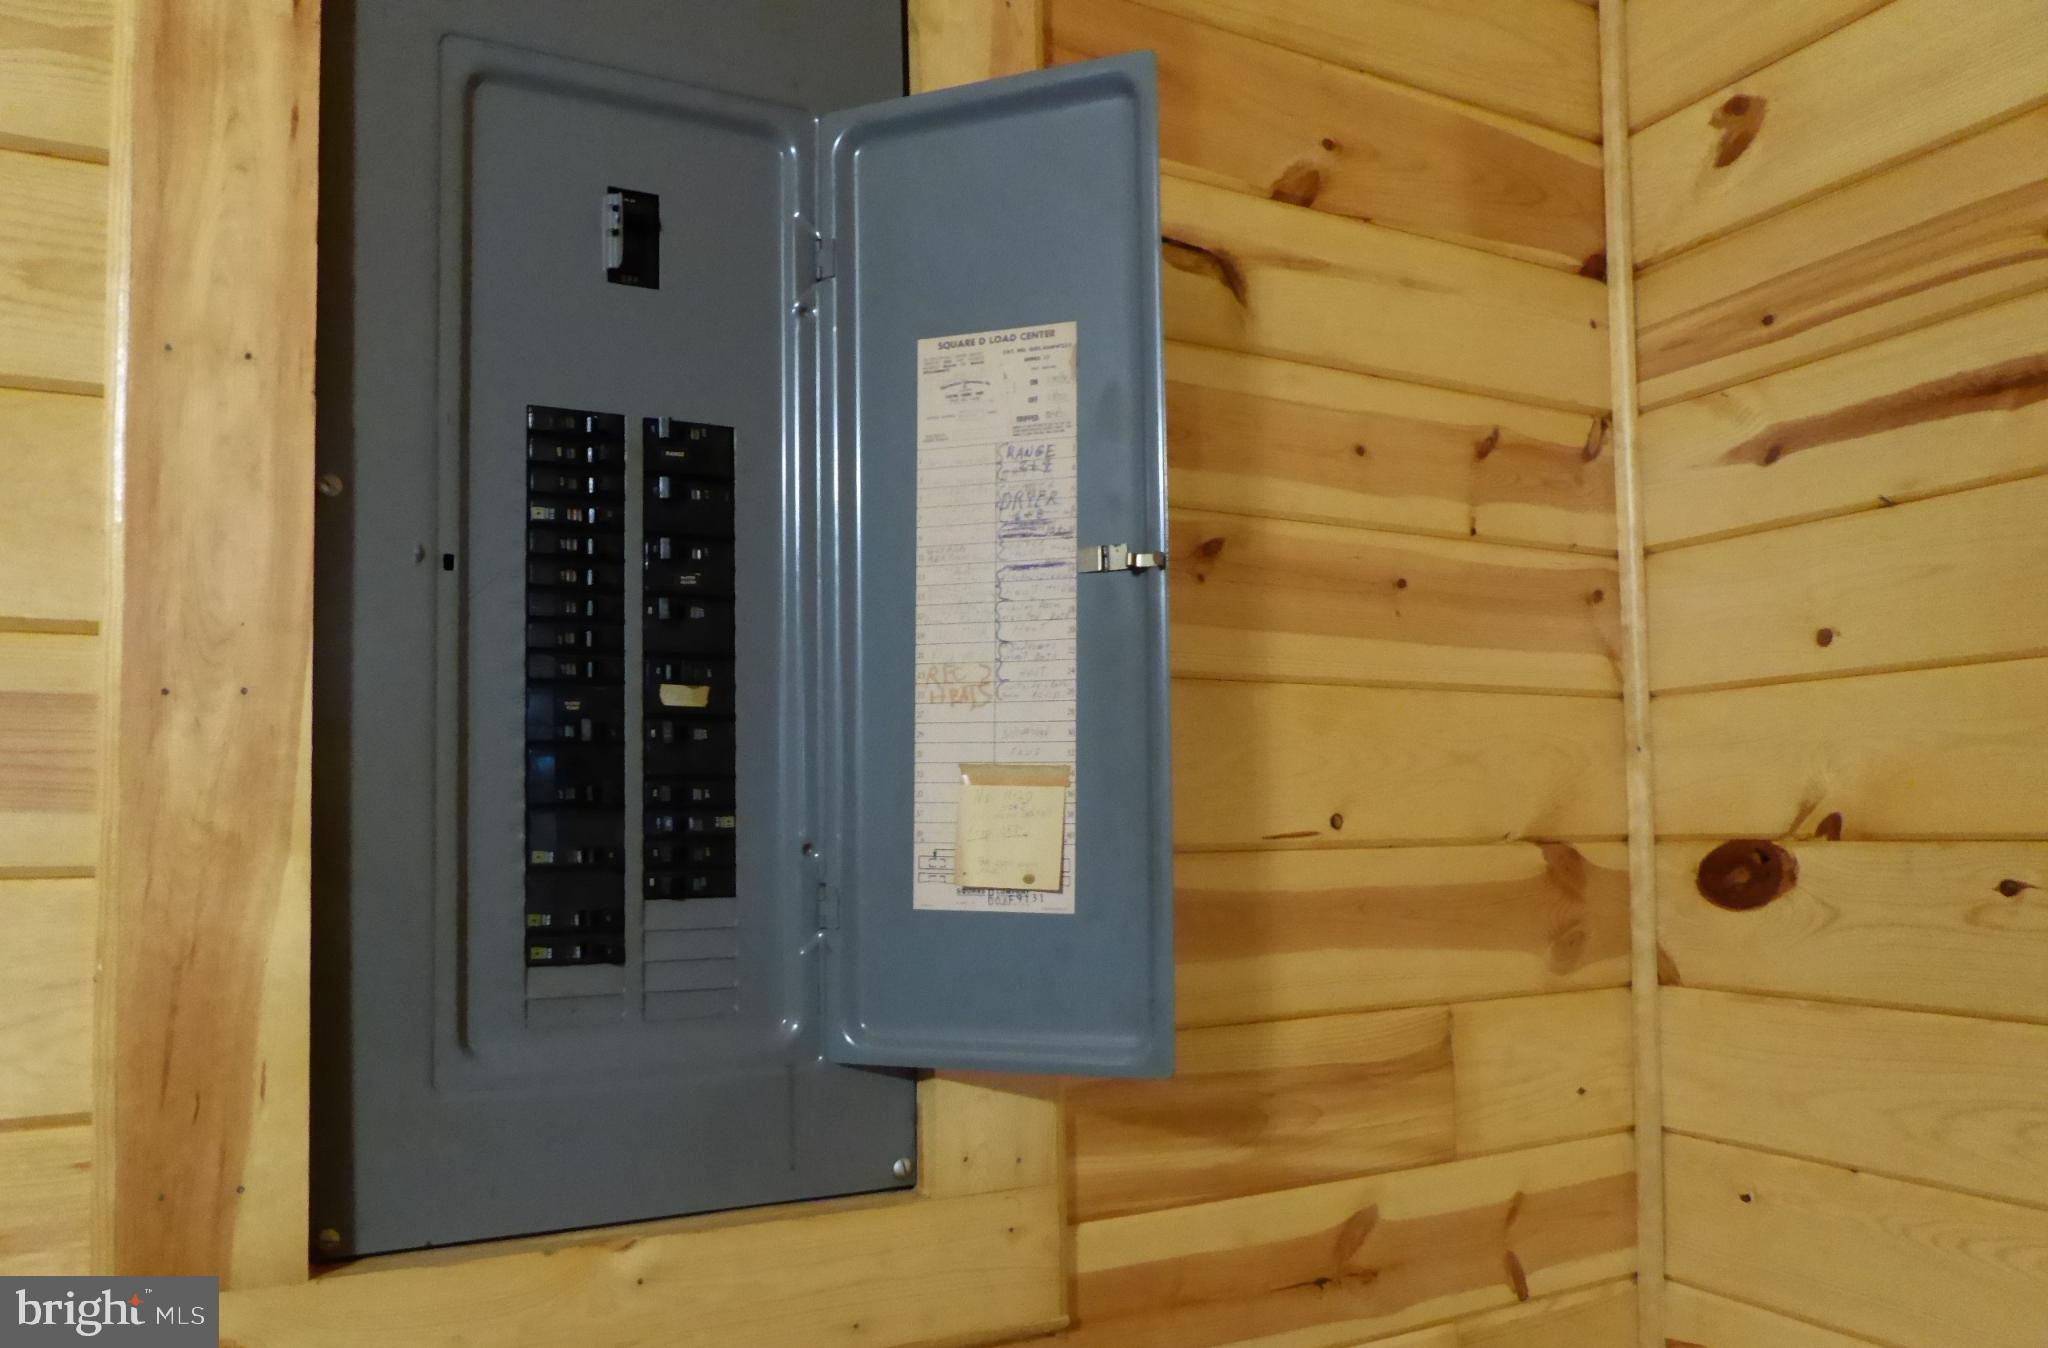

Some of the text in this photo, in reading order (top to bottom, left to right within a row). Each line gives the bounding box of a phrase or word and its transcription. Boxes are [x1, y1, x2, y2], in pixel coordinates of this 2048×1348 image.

[937, 329, 1056, 350] SQUARE D LOAD CENTER
[1006, 443, 1057, 461] RANGE
[999, 489, 1060, 511] DRYER
